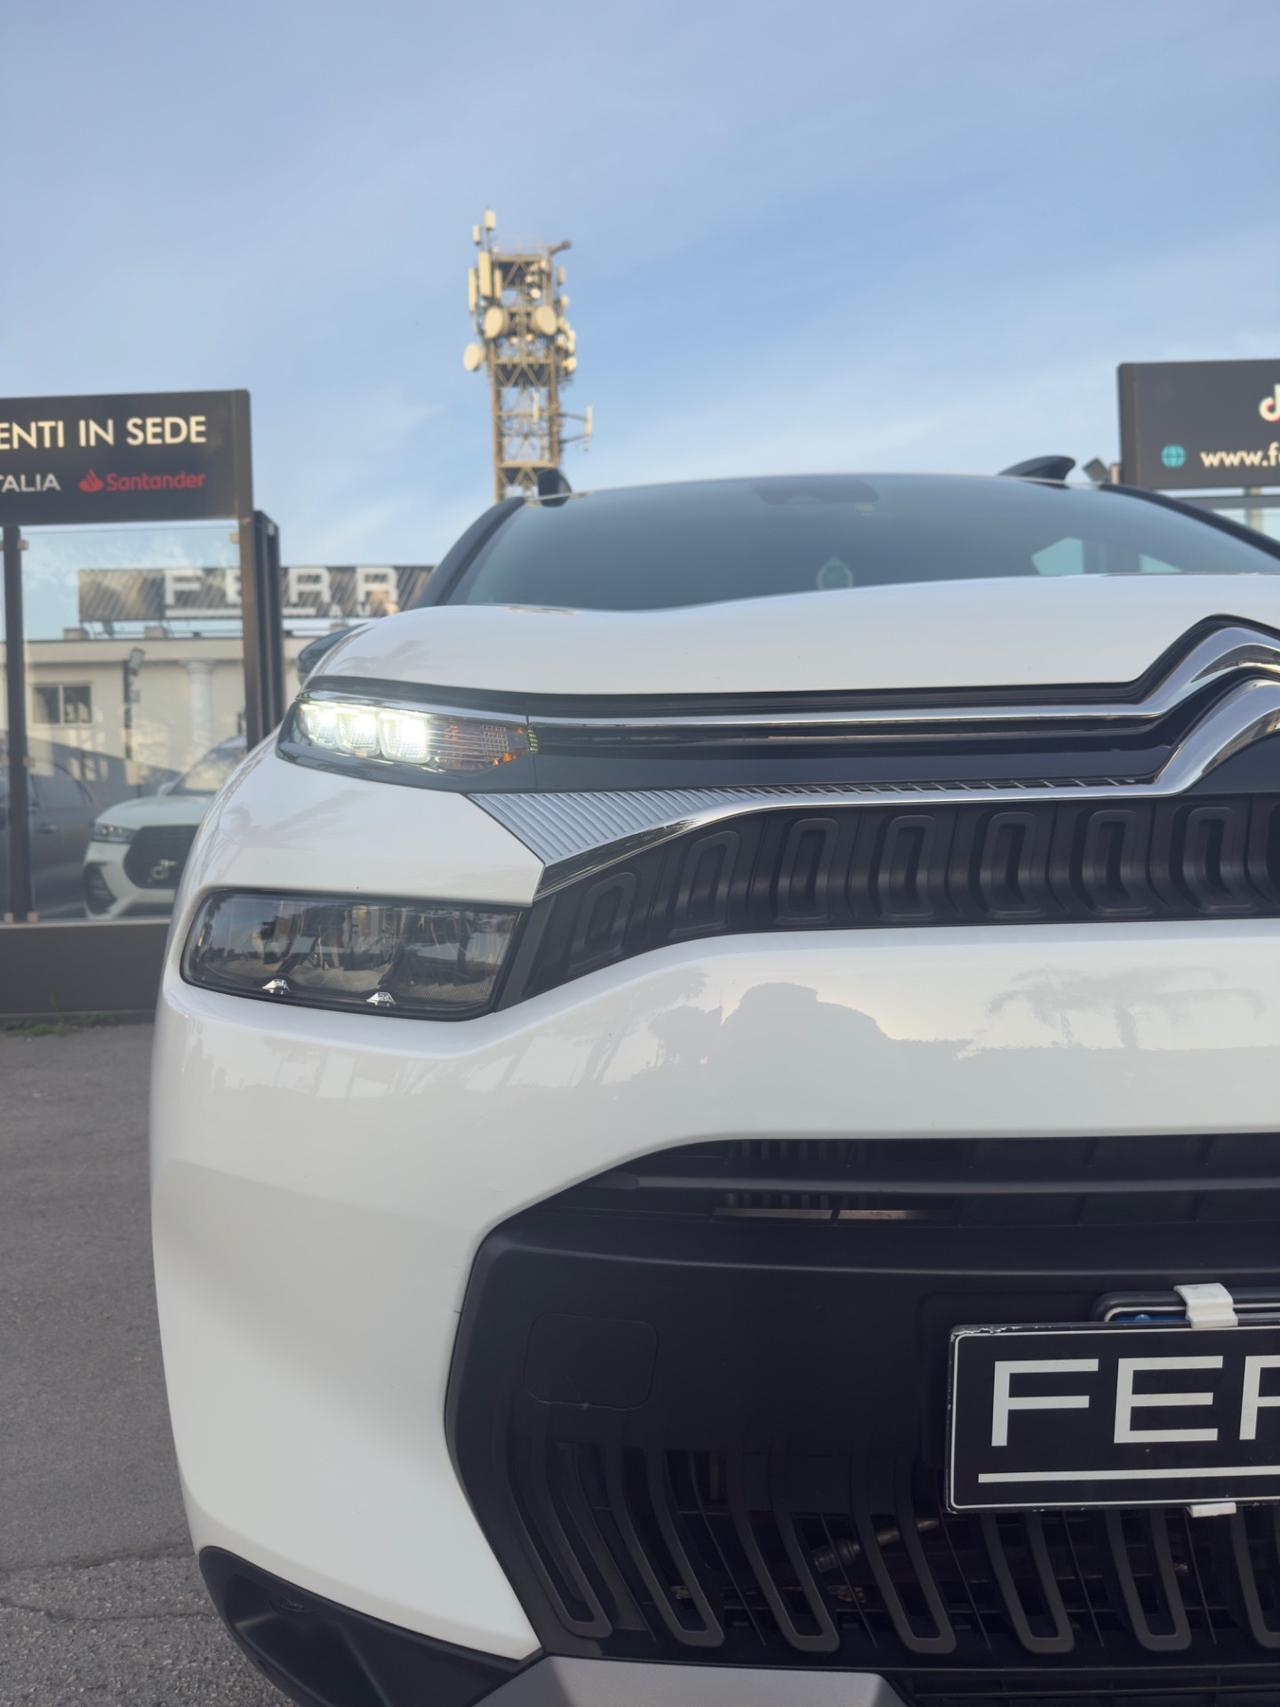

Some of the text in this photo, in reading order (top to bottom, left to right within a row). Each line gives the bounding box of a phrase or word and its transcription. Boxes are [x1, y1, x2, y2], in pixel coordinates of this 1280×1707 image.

[0, 415, 207, 450] ENTI IN SEDE
[1200, 441, 1280, 467] www.f
[106, 471, 206, 492] Santander
